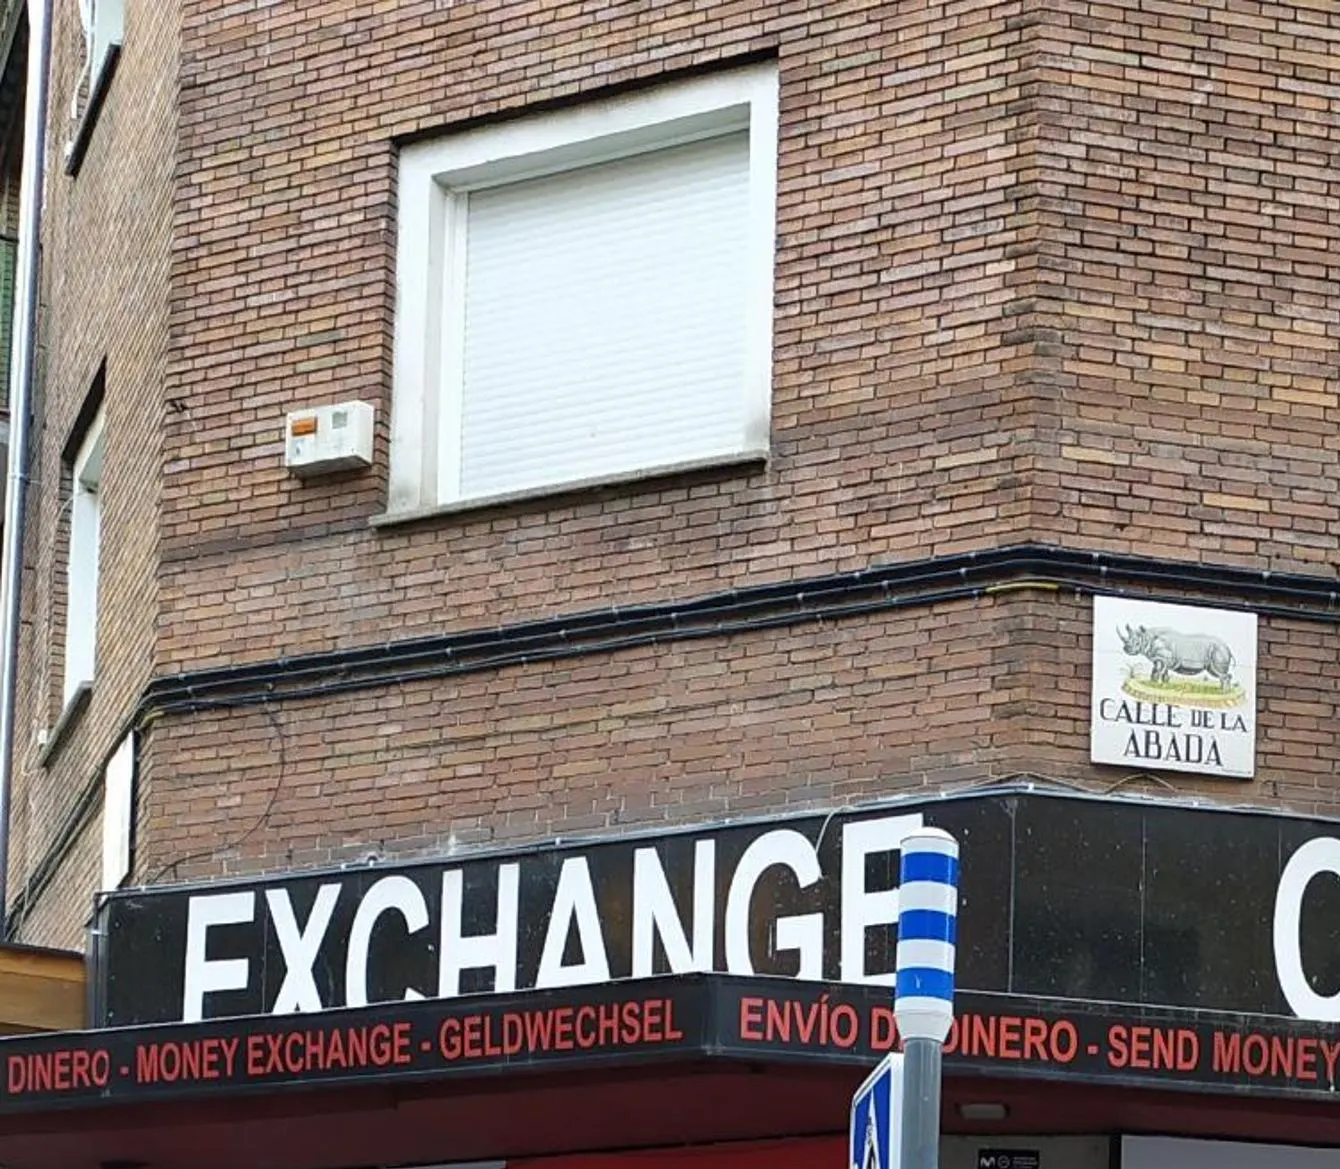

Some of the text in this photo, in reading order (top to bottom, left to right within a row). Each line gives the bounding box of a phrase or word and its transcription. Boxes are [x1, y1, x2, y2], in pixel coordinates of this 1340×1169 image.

[1100, 698, 1247, 732] CALLE DE LA
[1124, 728, 1223, 767] ABADA
[182, 812, 924, 1023] EXCHANGE
[8, 1049, 111, 1094] DINERO
[136, 1037, 240, 1084] MONEY
[247, 1023, 412, 1076] EXCHANGE
[439, 997, 683, 1059] GELDWECHSEL
[739, 994, 859, 1049] ENVÍO
[870, 1006, 905, 1052] D
[1107, 1025, 1200, 1072] SEND
